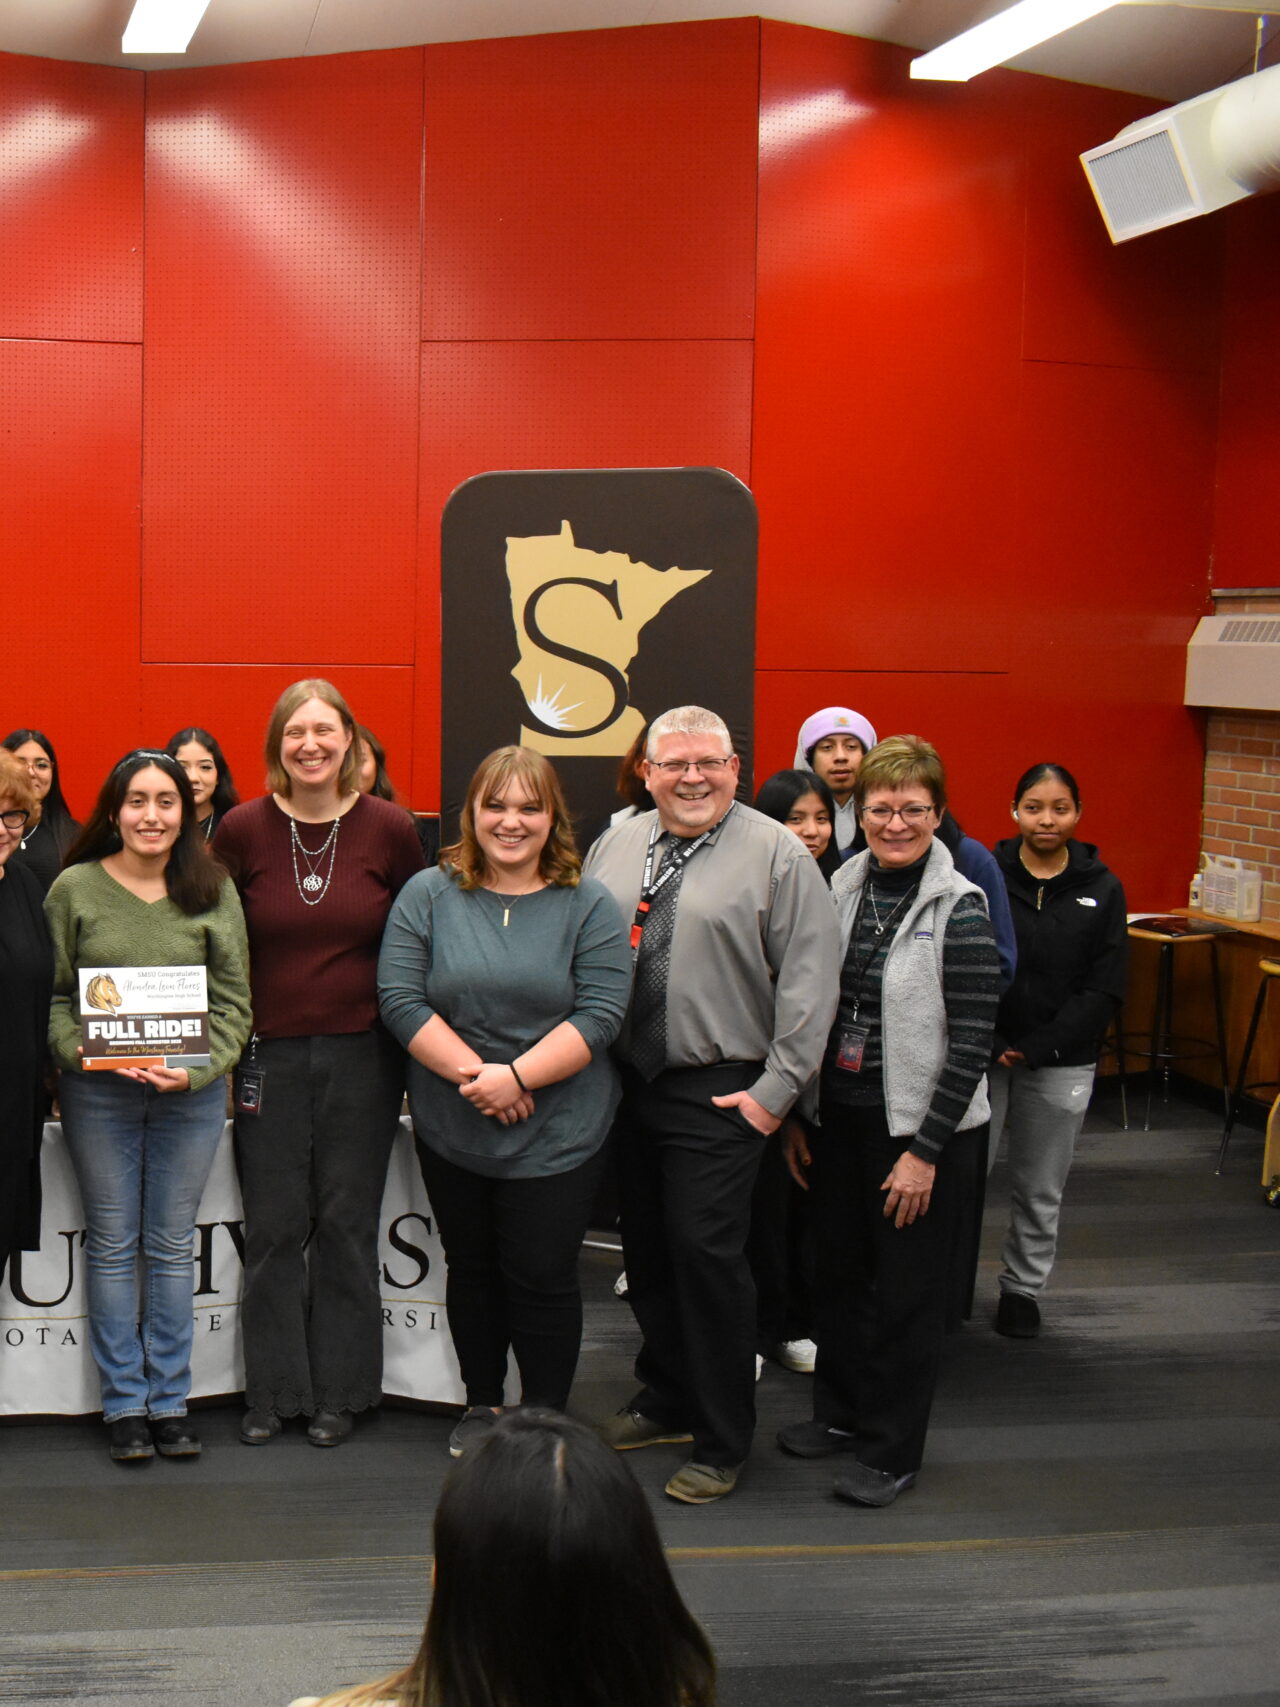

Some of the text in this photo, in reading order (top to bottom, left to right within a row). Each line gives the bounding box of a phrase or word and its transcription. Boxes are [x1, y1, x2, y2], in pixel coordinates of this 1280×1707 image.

[521, 577, 629, 739] S
[157, 970, 200, 978] Congratulates
[176, 978, 201, 990] Flores
[88, 1019, 202, 1039] FULL RIDE!
